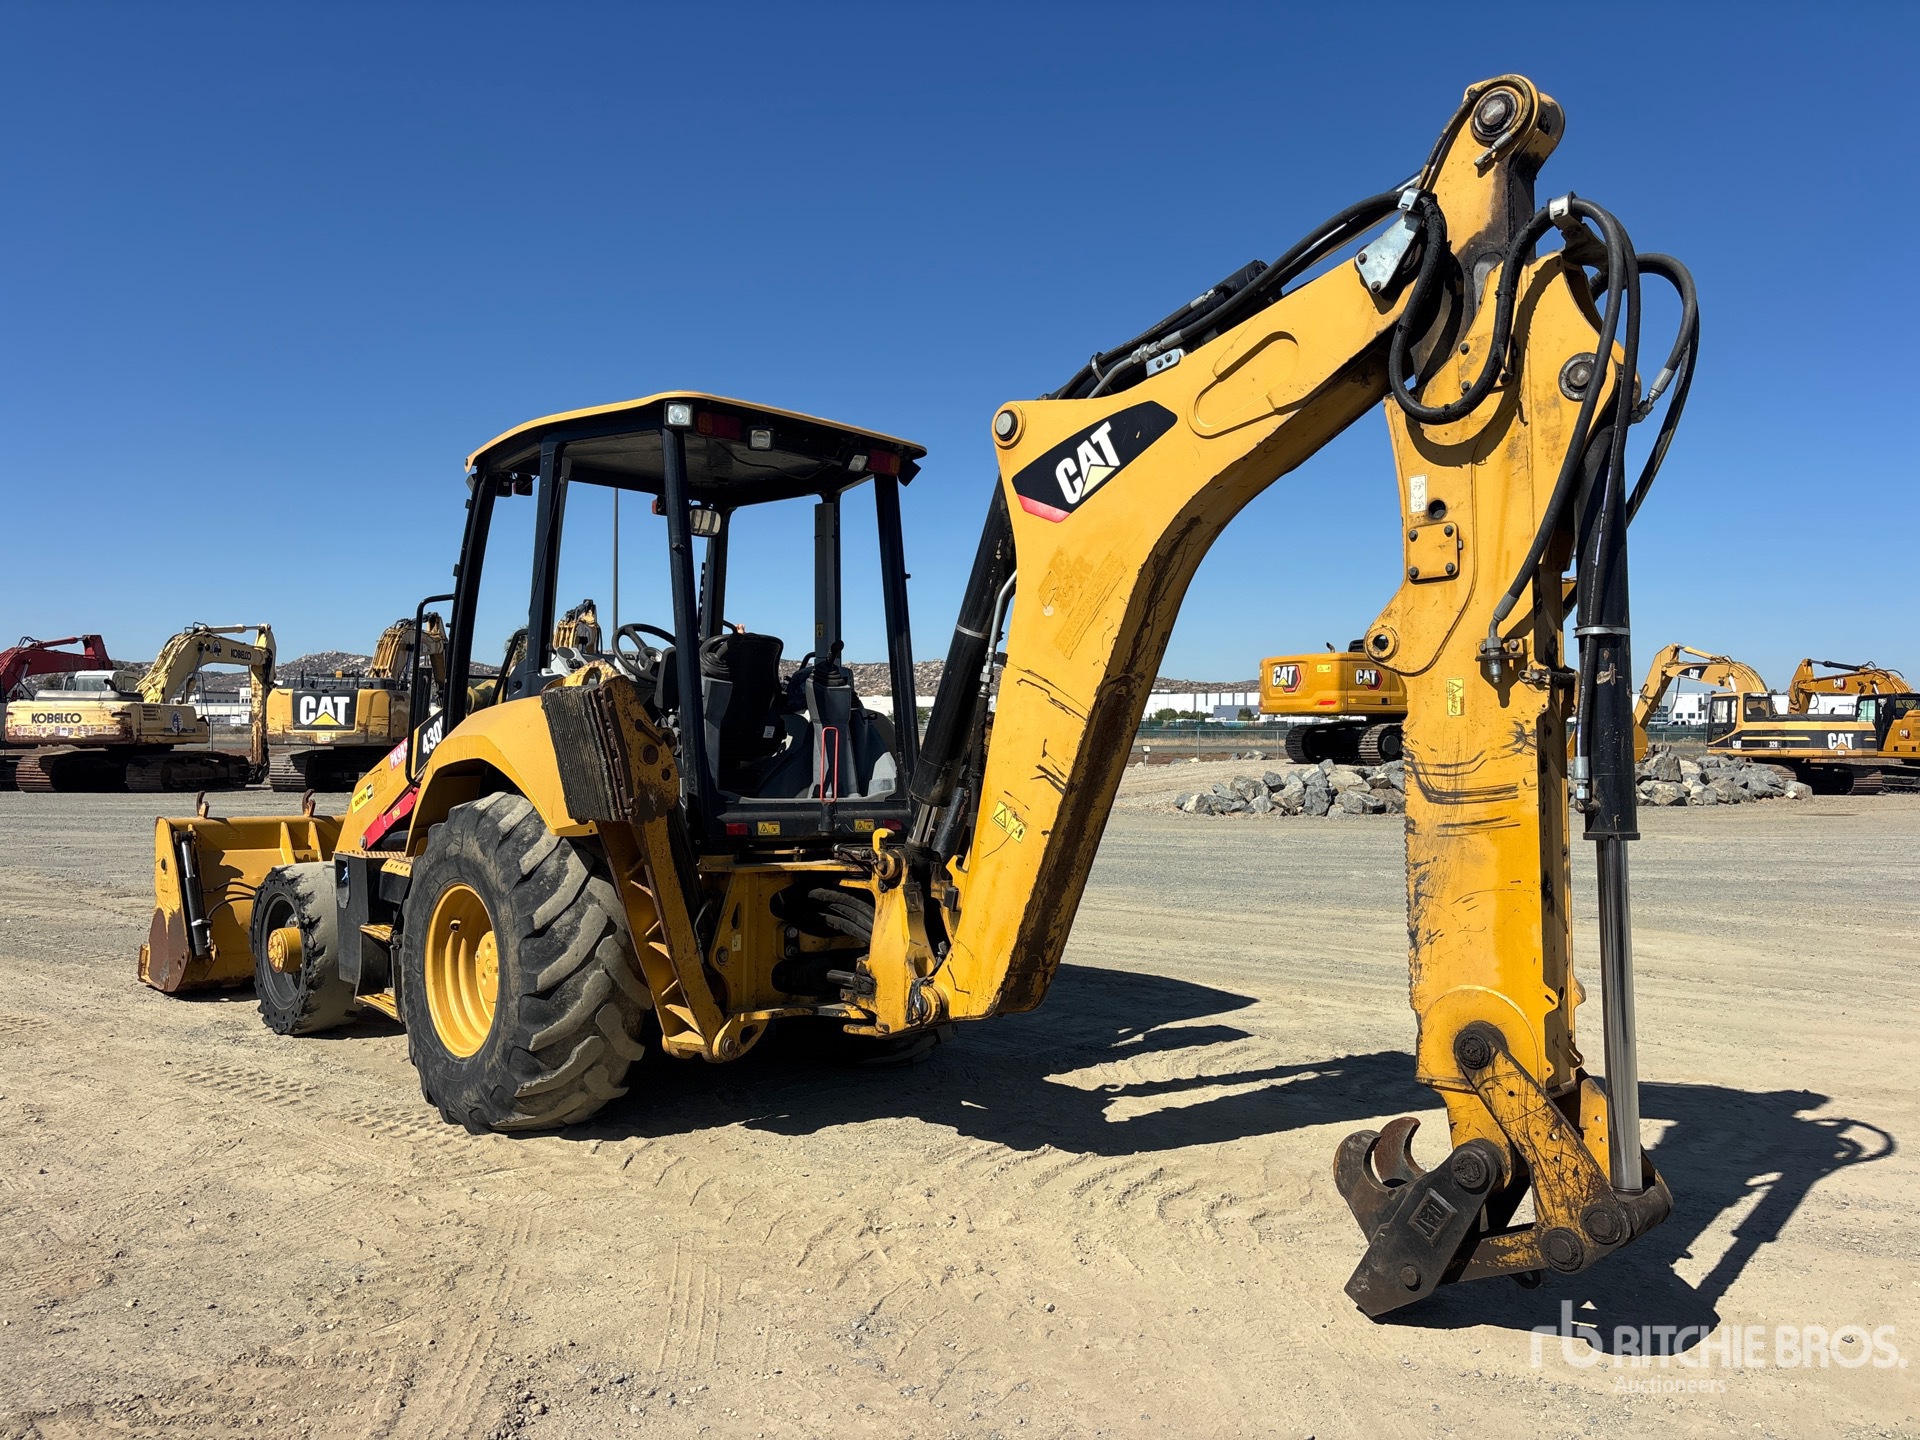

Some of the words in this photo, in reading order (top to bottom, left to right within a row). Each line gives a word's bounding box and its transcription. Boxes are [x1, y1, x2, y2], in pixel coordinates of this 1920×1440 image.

[1055, 421, 1121, 504] CAT
[1272, 665, 1296, 687] CAT
[1355, 669, 1377, 685] CAT
[1689, 668, 1700, 680] CAT
[1833, 678, 1844, 689] CAT
[31, 712, 82, 724] KOBELCO
[299, 695, 350, 726] CAT
[1827, 732, 1854, 750] CAT
